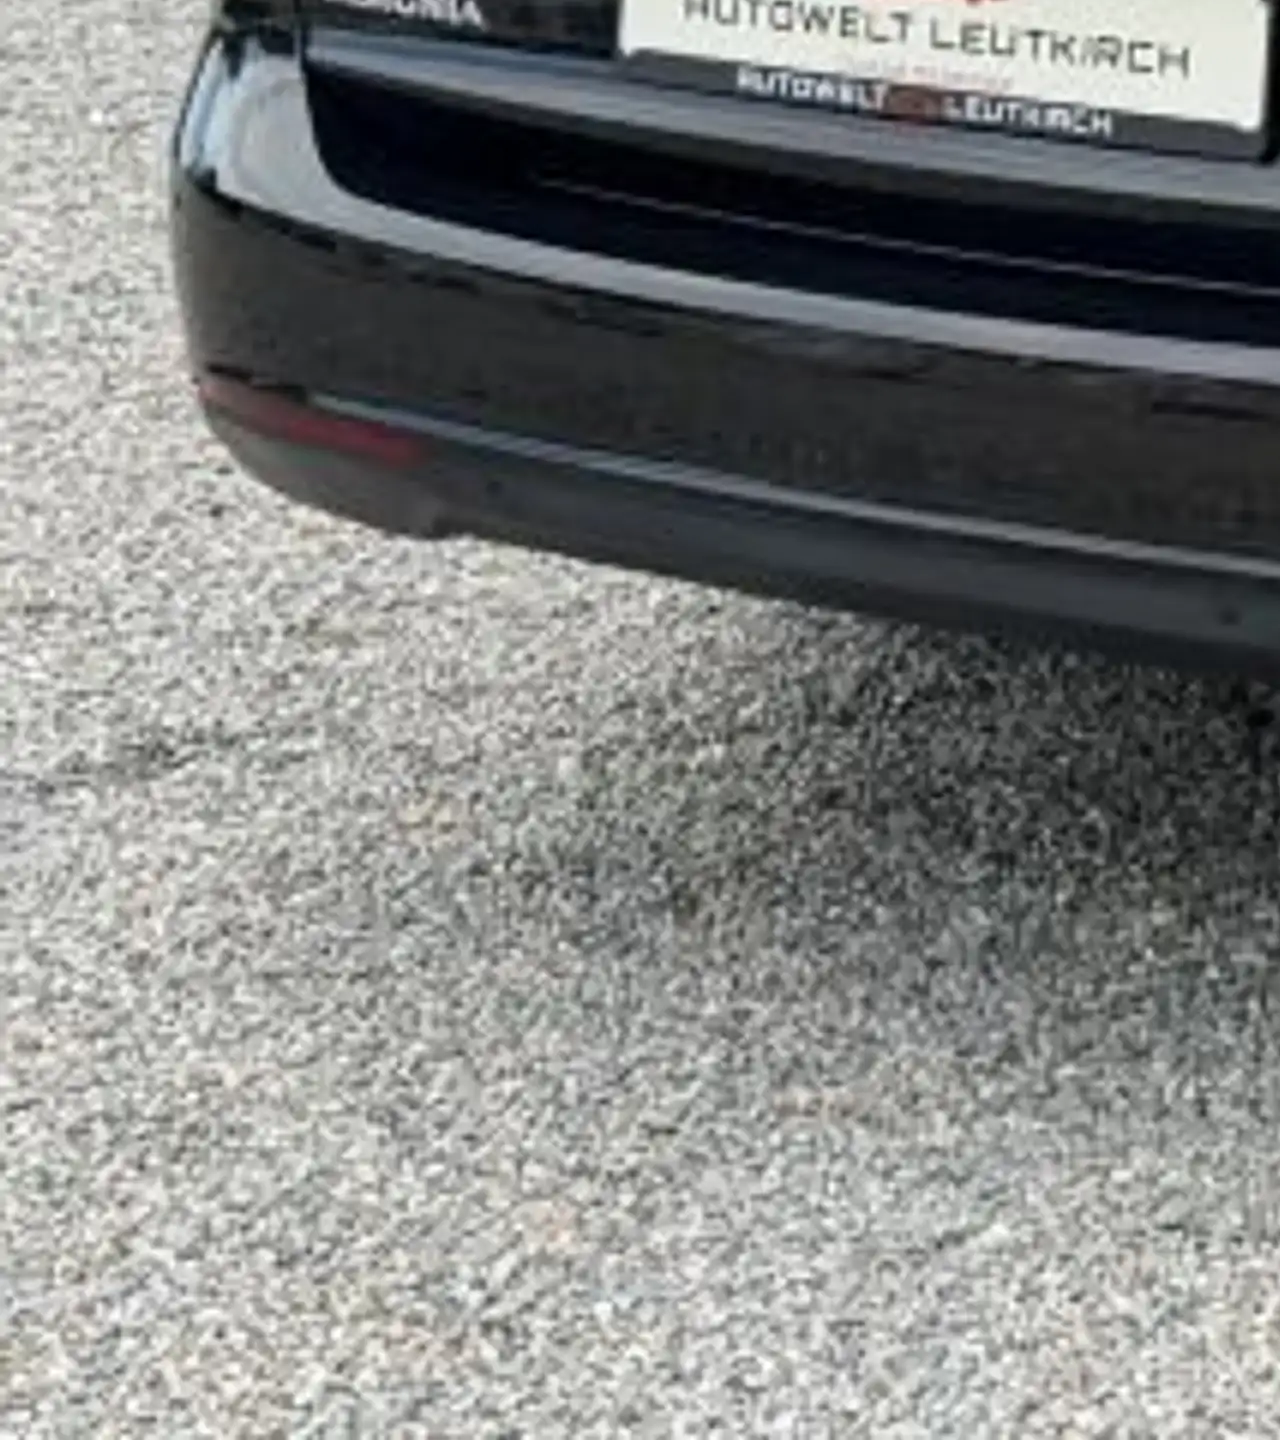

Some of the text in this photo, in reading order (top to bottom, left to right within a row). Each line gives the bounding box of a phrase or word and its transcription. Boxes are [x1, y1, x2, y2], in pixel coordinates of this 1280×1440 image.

[927, 17, 1192, 79] LEUTKIRCH
[736, 66, 888, 110] AUTOWELT
[942, 96, 1114, 137] LEUTKIRCH
